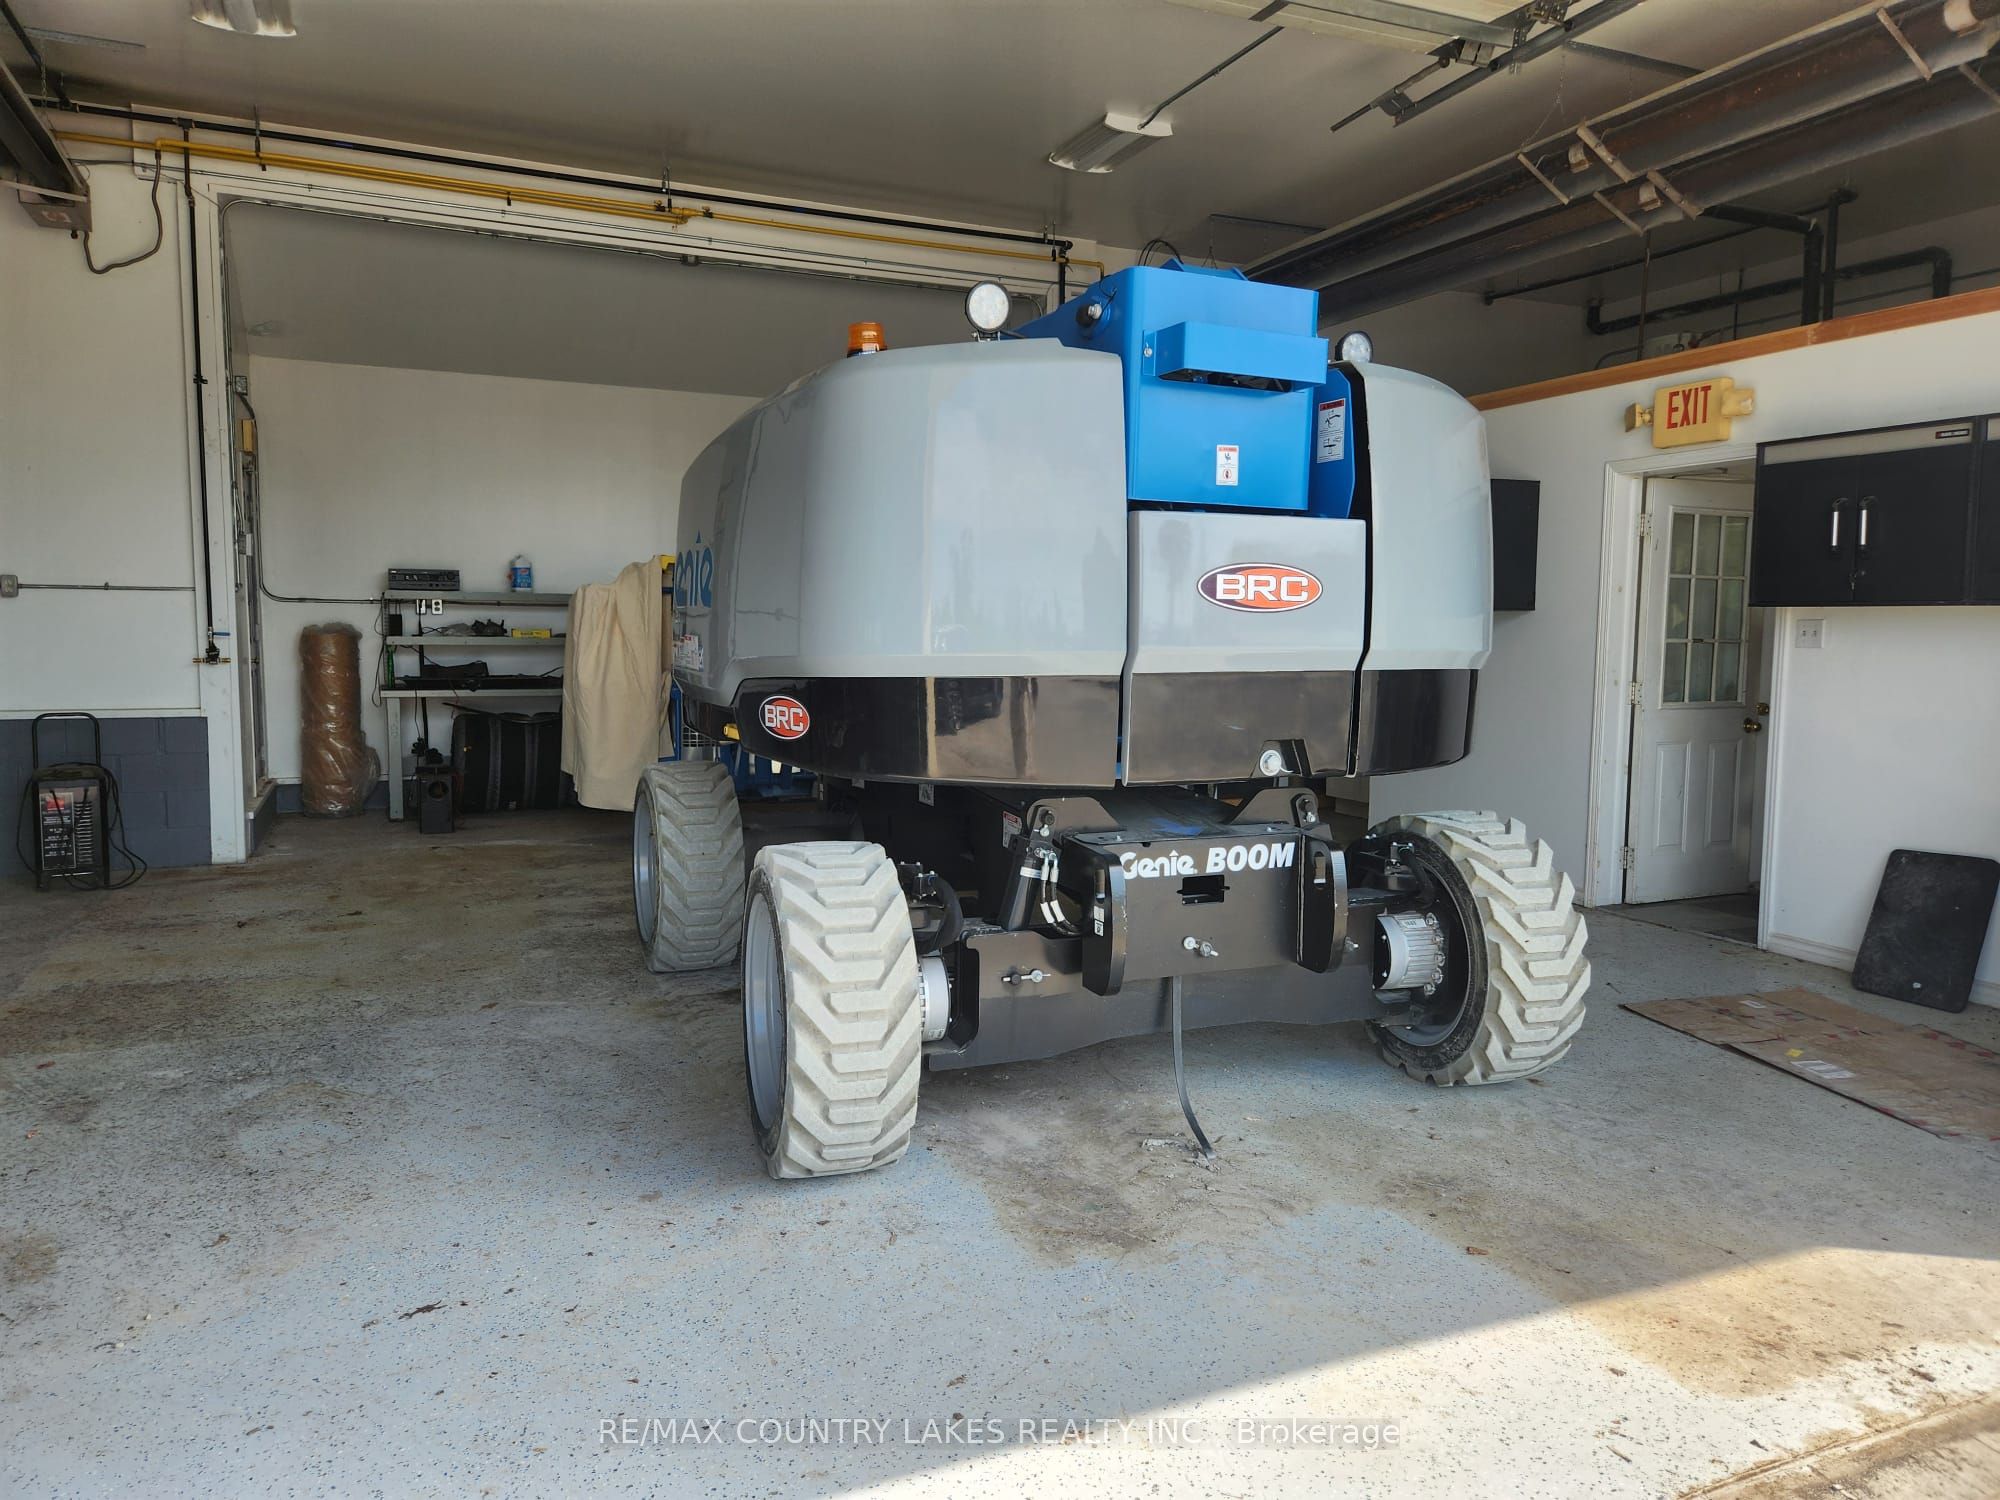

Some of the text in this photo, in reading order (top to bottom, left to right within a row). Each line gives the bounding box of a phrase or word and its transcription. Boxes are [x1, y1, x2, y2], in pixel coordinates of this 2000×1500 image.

[1666, 385, 1712, 429] EXIT
[674, 529, 714, 608] enie
[1215, 573, 1309, 602] BRC
[764, 703, 804, 732] BRC
[1119, 841, 1296, 880] Genie BOOM
